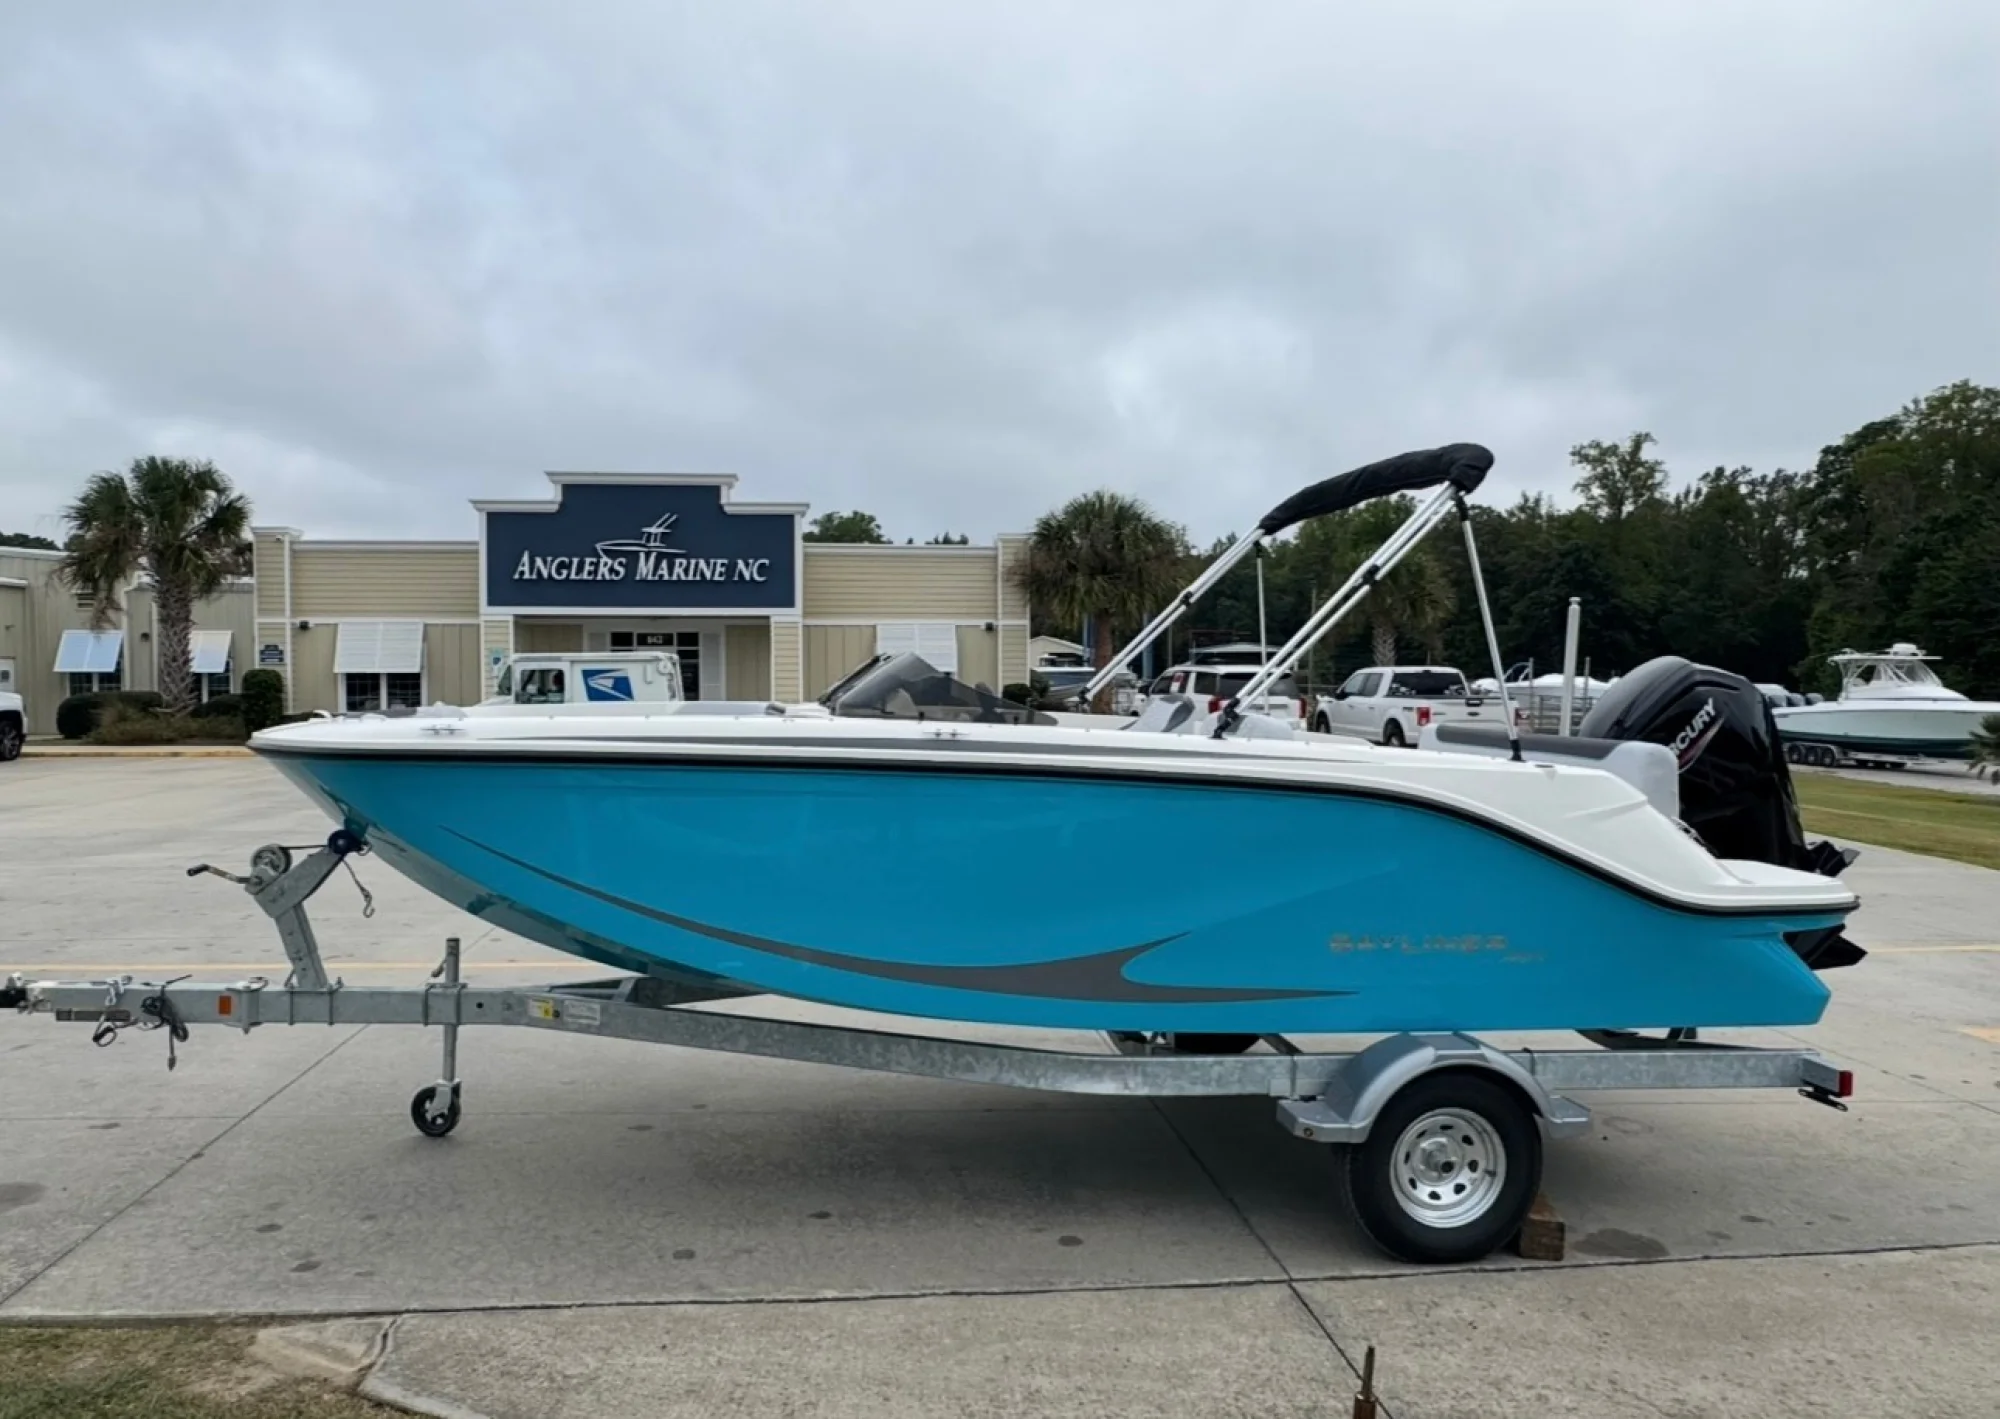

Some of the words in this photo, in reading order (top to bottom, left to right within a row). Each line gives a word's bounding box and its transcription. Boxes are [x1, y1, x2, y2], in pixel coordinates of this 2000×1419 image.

[513, 550, 626, 580] ANGLERS
[635, 551, 728, 581] MARINE
[733, 559, 769, 581] NC
